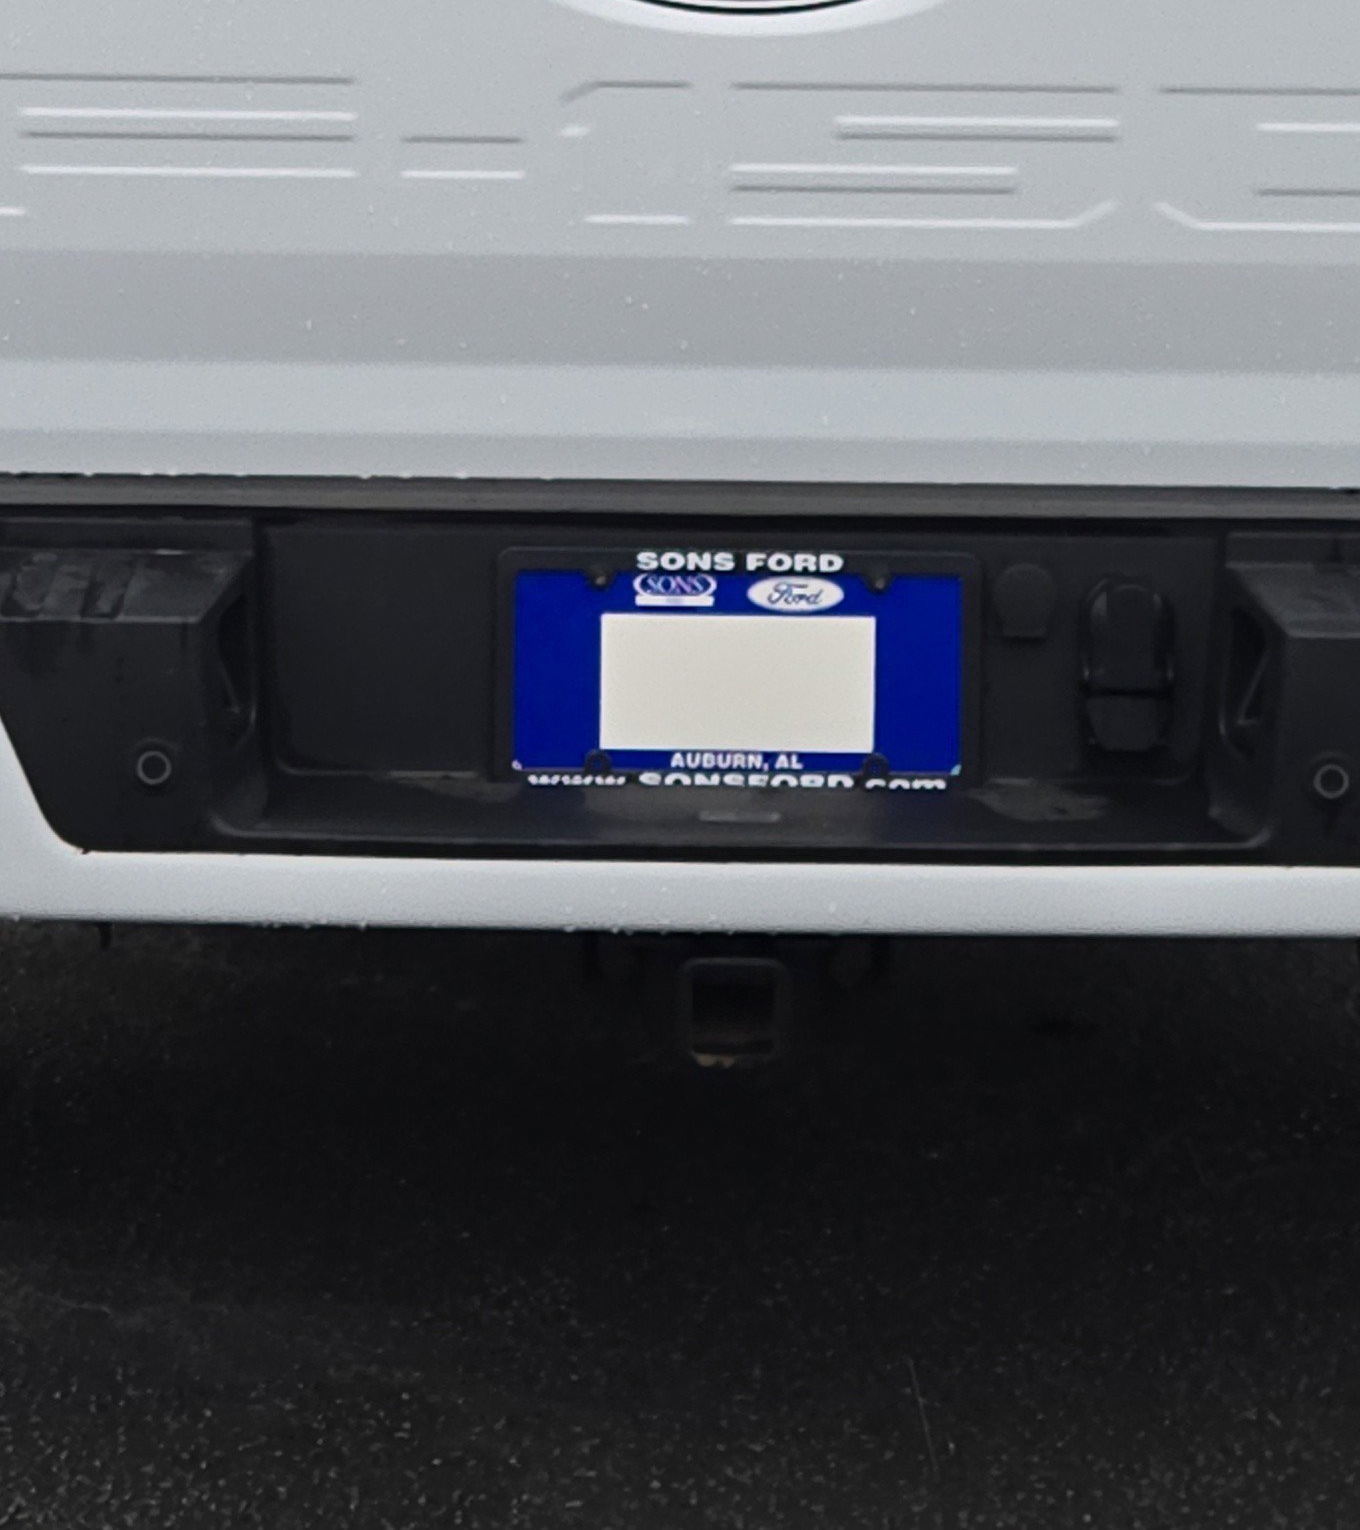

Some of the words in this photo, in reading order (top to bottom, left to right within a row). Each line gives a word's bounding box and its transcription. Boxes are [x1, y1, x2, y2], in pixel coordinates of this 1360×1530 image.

[636, 551, 735, 571] SONS
[746, 553, 844, 572] FORD
[646, 574, 704, 594] SONS
[766, 581, 825, 606] Ford
[670, 753, 770, 771] AUBURN,
[774, 754, 804, 770] AL
[527, 771, 948, 790] wwwSONSFORDcom
